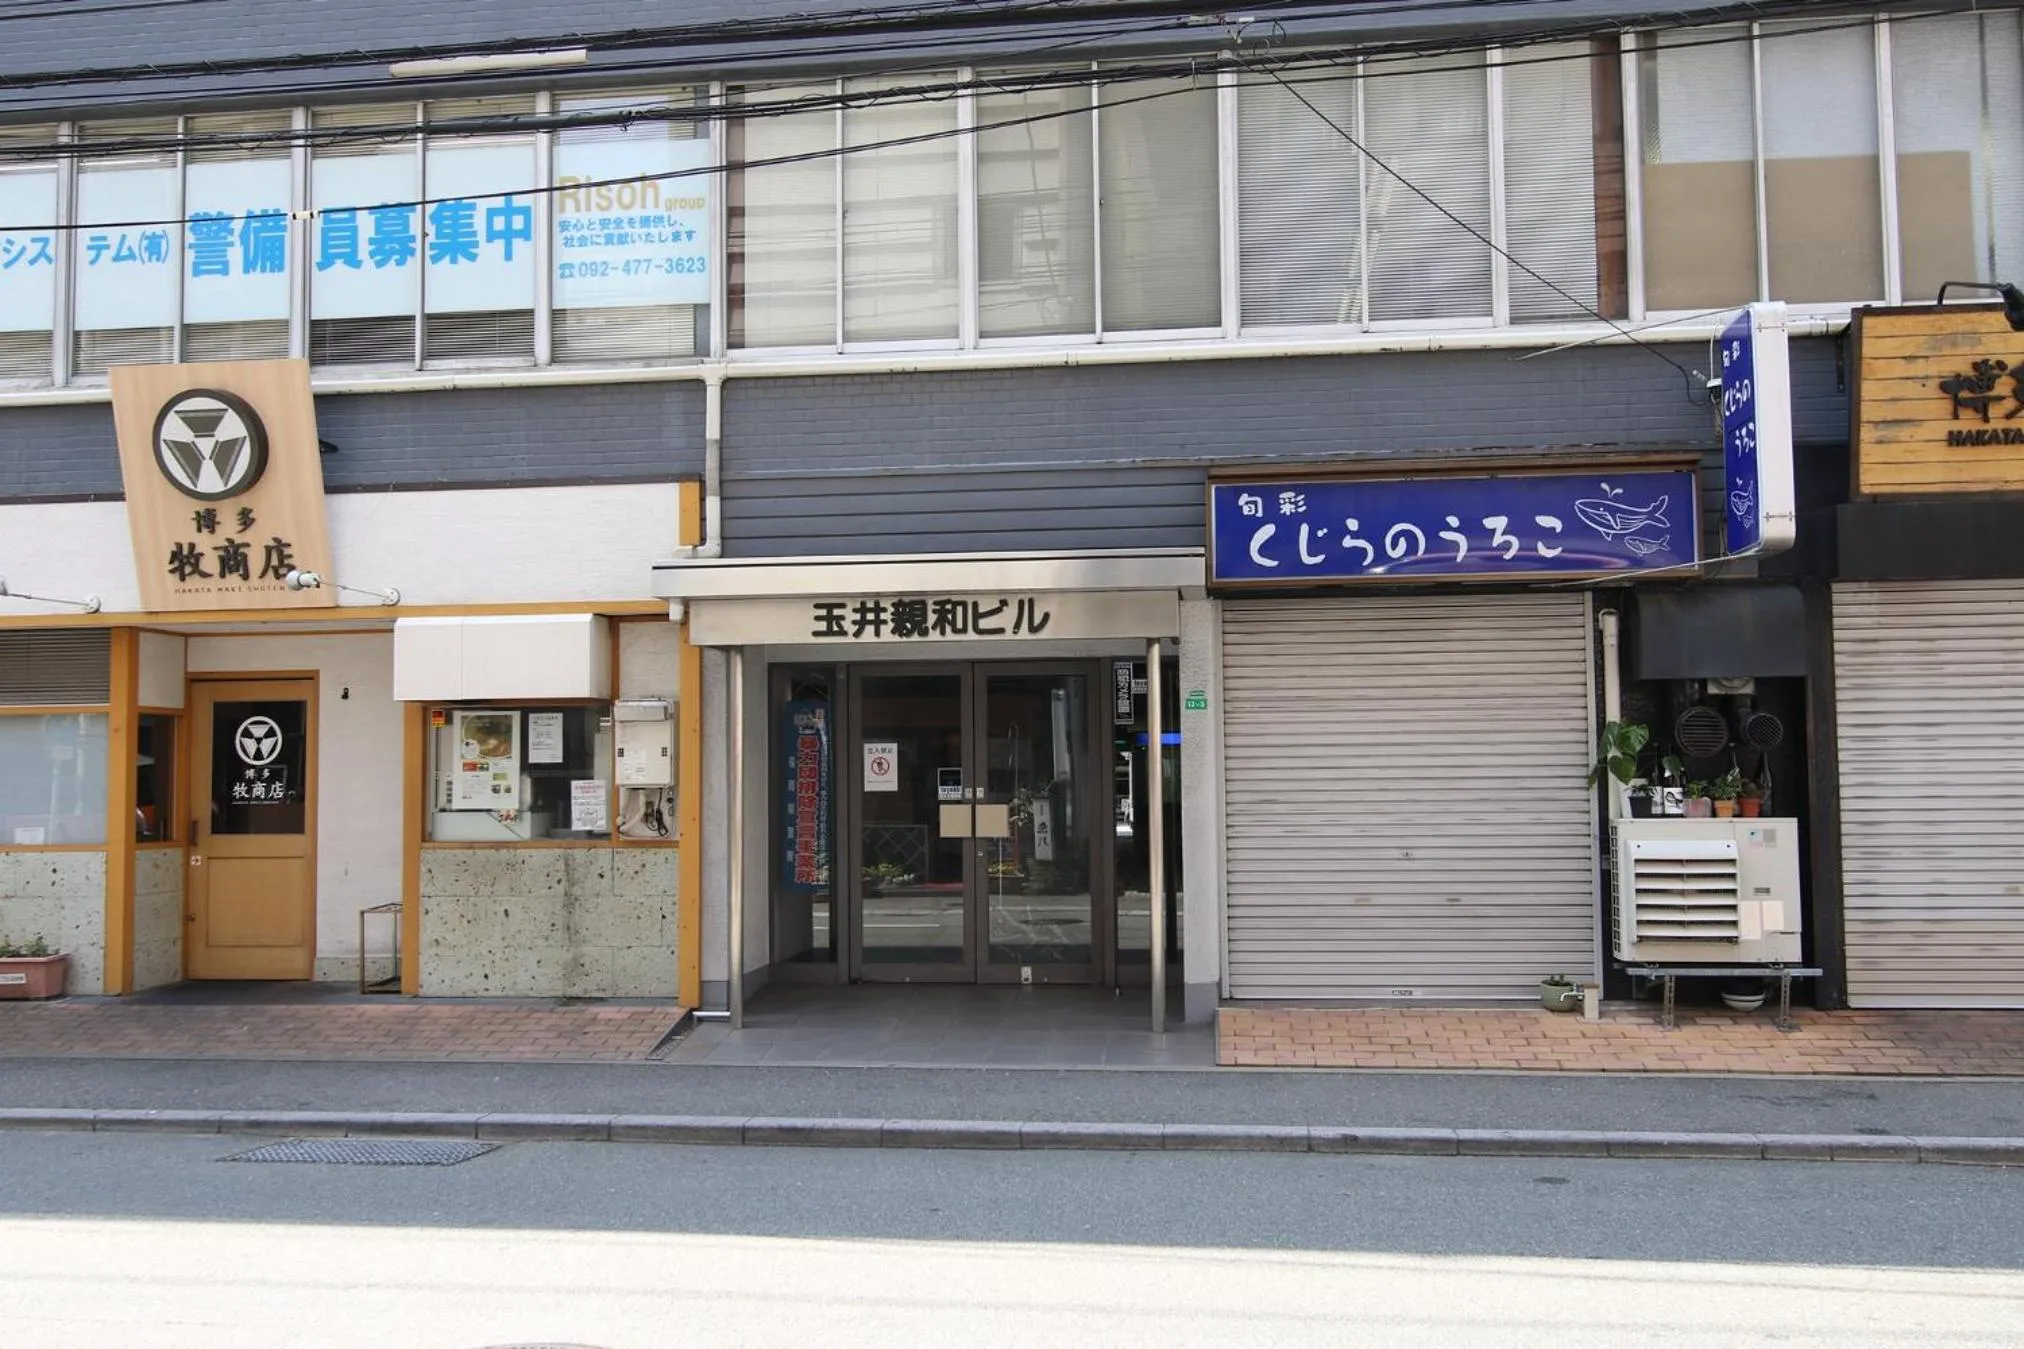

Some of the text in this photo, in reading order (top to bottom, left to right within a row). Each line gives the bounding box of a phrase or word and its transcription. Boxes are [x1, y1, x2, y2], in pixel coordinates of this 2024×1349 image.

[558, 172, 706, 214] Risoh group
[188, 194, 532, 277] 警備員募集中
[1735, 422, 1756, 458] うろこ
[191, 507, 257, 535] 博多
[1238, 491, 1307, 517] 旬彩
[168, 536, 298, 582] 牧商店
[1249, 515, 1563, 568] くじらのうろこ
[811, 597, 1051, 638] 玉井親和ビル
[231, 781, 285, 800] 牧商店
